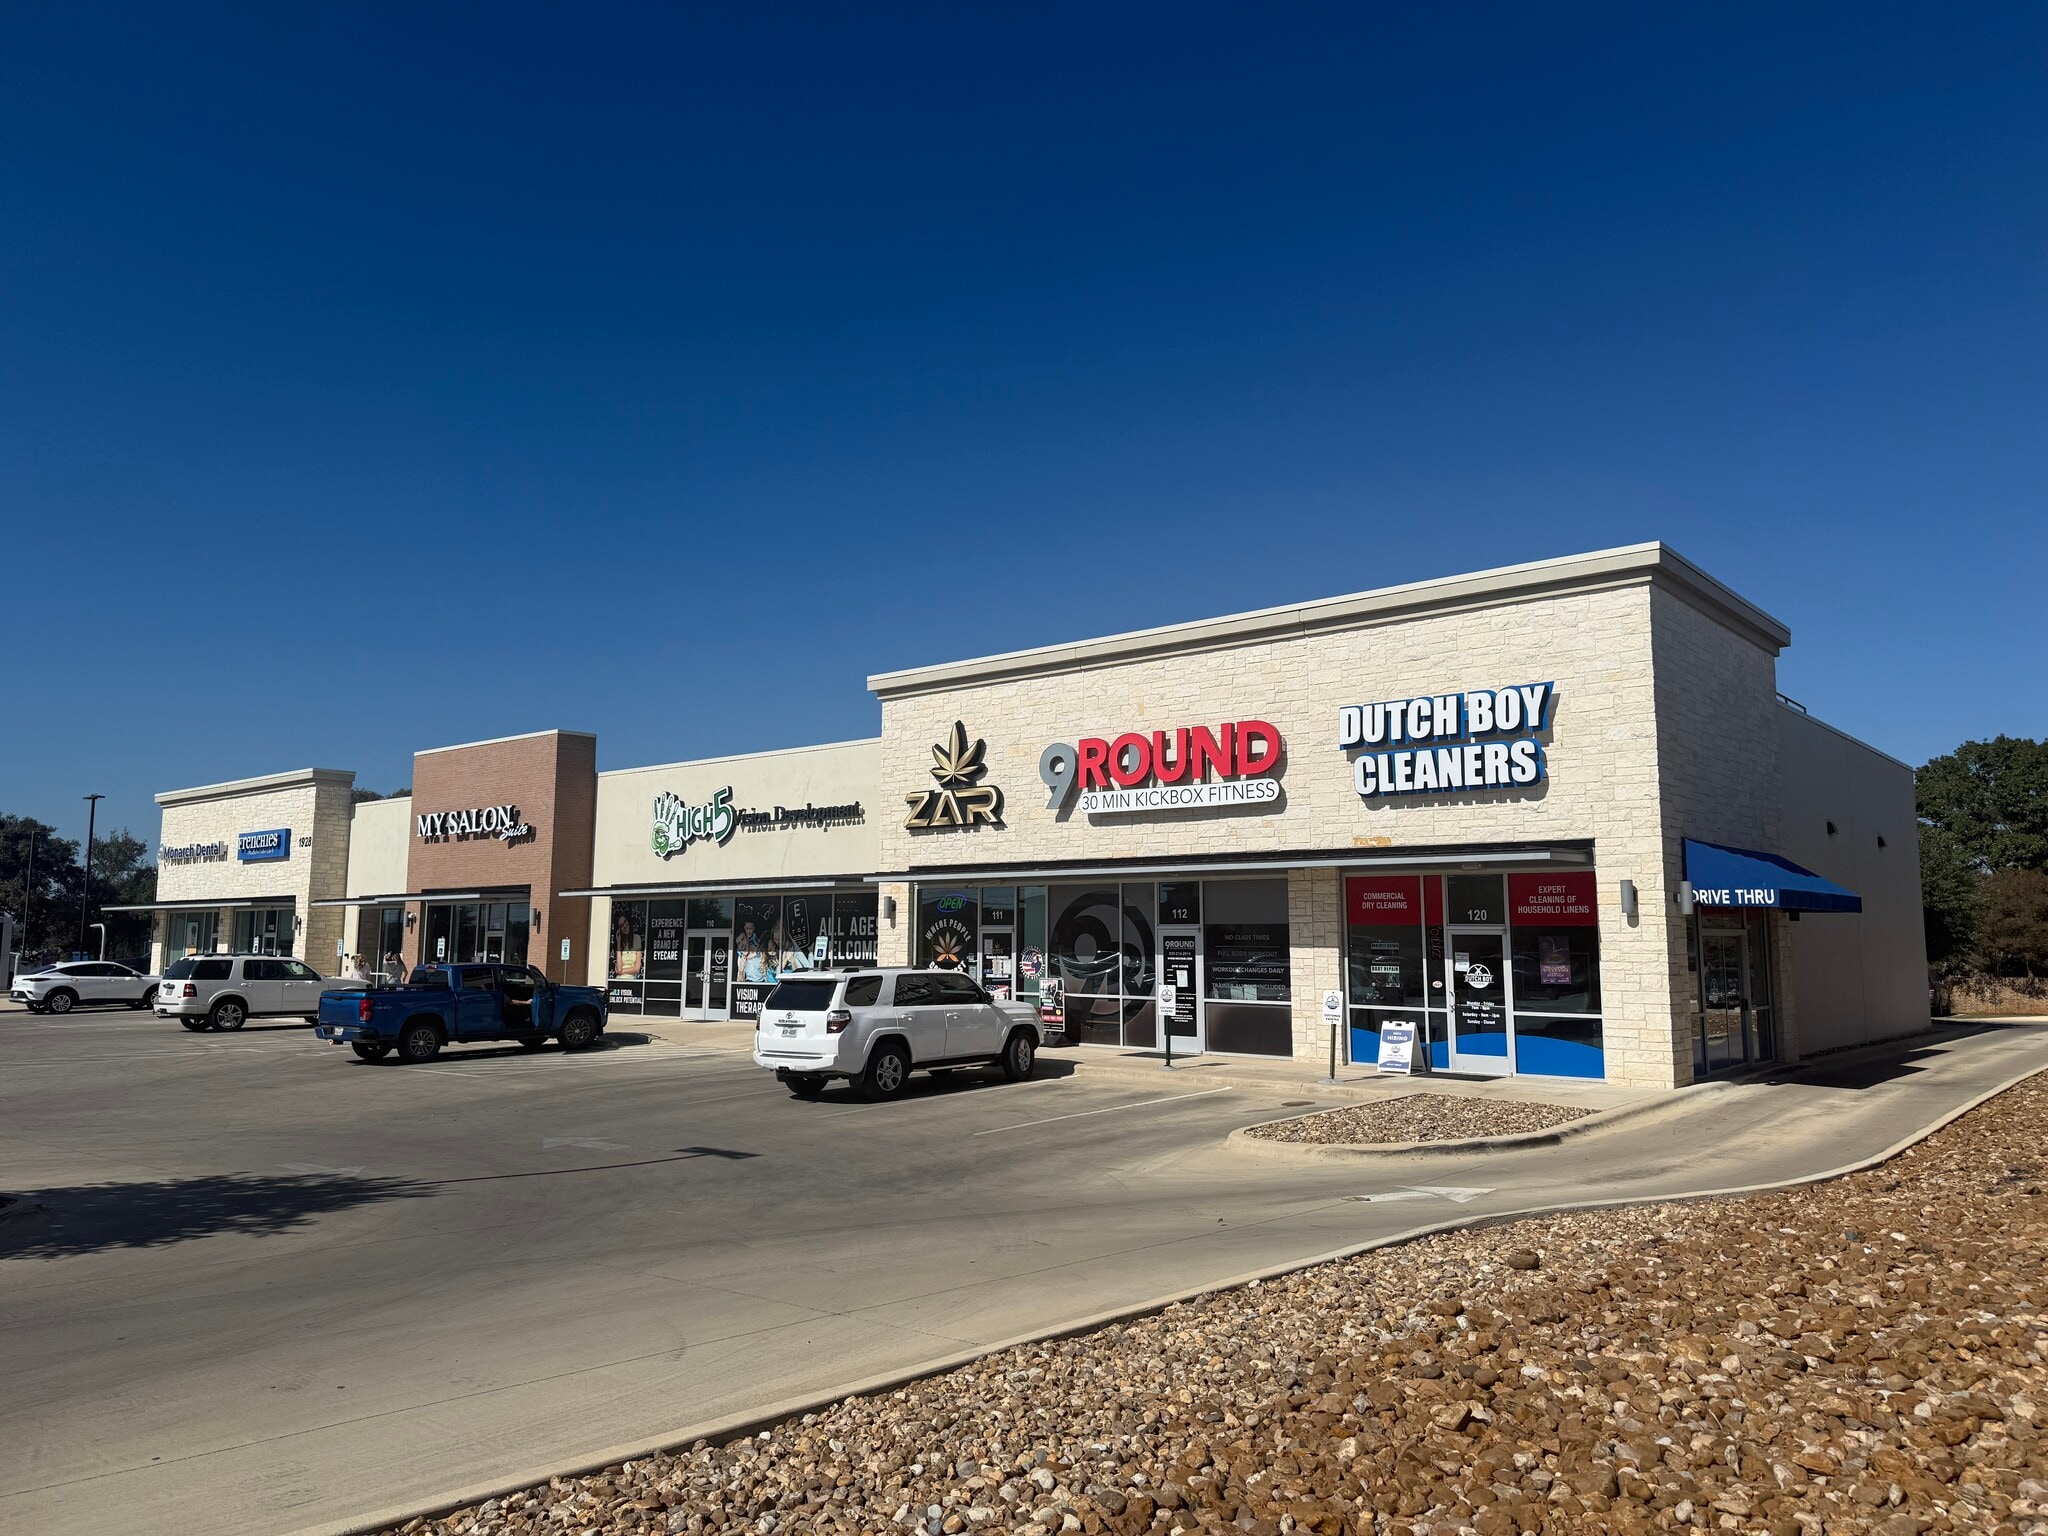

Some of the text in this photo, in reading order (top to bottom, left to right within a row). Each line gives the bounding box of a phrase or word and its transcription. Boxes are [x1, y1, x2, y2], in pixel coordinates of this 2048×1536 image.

[1339, 685, 1546, 745] DUTCH BOY
[1039, 720, 1281, 810] 9ROUND
[1354, 740, 1537, 795] CLEANERS
[1082, 781, 1276, 809] 30 MIN KICKBOX FITNESS
[734, 808, 771, 826] Vision
[774, 801, 862, 823] Development
[903, 787, 1000, 829] ZAR
[417, 805, 513, 837] MY SALON
[499, 821, 528, 841] Suite
[299, 837, 312, 848] 1928
[163, 840, 221, 859] Monarch Dental
[1363, 892, 1406, 900] COMMERCIAL
[1538, 885, 1566, 894] EXPERT
[1529, 895, 1577, 904] CLEANING OF
[1692, 889, 1775, 904] DRIVE THRU
[793, 903, 801, 917] E
[939, 897, 964, 910] OPEN
[1375, 901, 1408, 909] CLEANING
[1517, 905, 1590, 914] HOUSEHOLD LINENS
[992, 911, 1003, 920] 111
[1172, 908, 1188, 919] 112
[1467, 909, 1487, 921] 120
[652, 918, 683, 928] EXPERIENCE
[819, 916, 878, 936] ALL AGE
[658, 929, 676, 939] A NEW
[925, 918, 972, 943] WHERE PEOPLE
[653, 940, 680, 949] BRAND OF
[828, 940, 878, 960] ELCOME
[1165, 940, 1195, 950] 9ROUND
[653, 951, 678, 961] EYECARE
[736, 988, 759, 1001] VISION
[735, 1001, 764, 1014] THERAP
